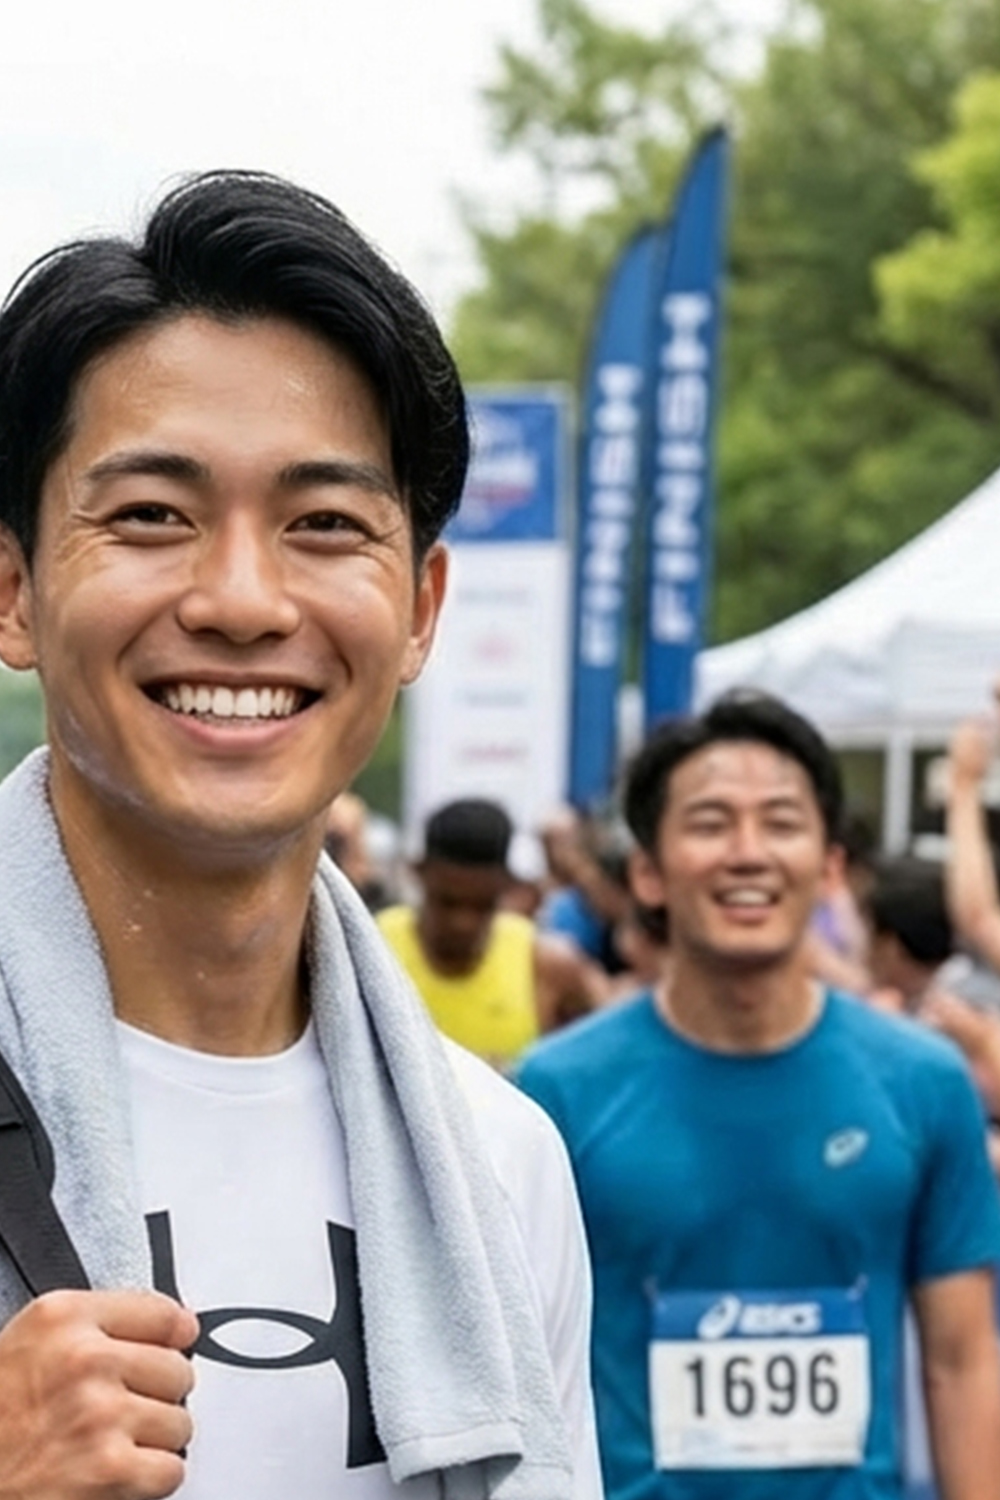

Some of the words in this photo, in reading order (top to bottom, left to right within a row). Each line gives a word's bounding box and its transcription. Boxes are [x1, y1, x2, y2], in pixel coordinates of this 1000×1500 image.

[579, 362, 643, 667] FINISH
[651, 292, 711, 642] FINISH
[686, 1352, 839, 1418] 1696
